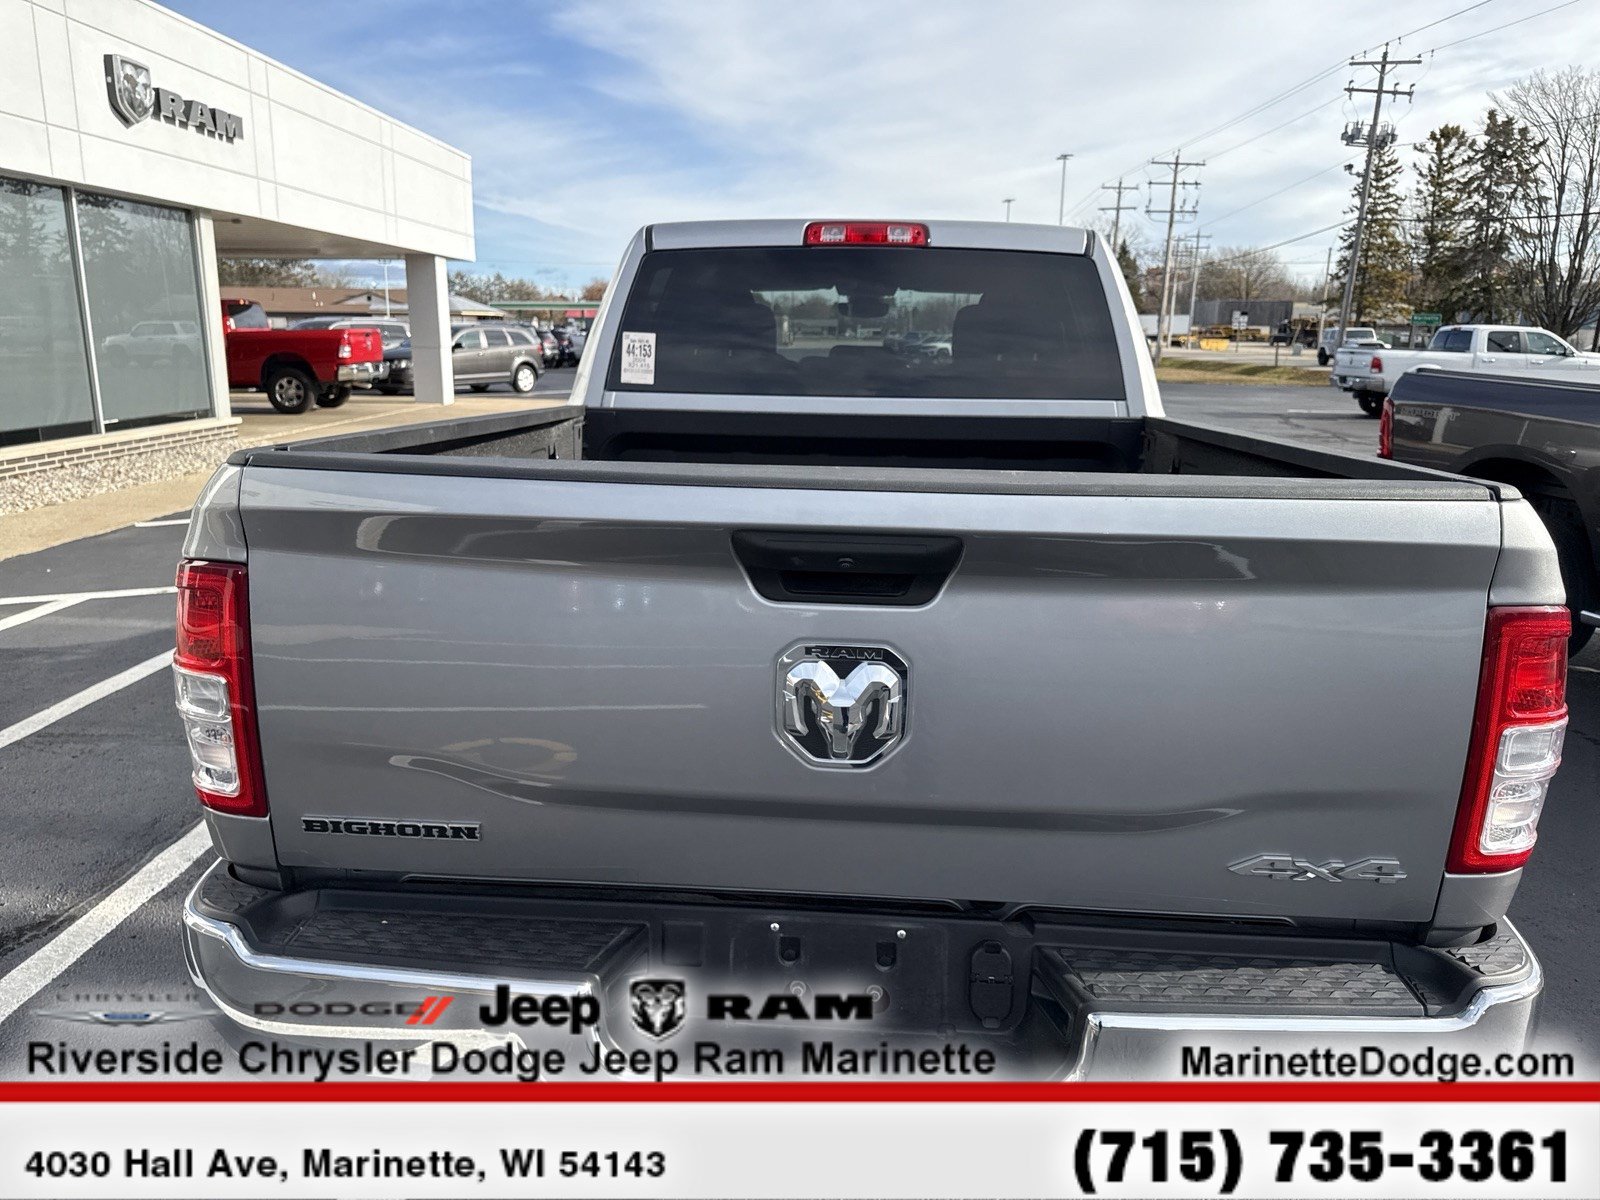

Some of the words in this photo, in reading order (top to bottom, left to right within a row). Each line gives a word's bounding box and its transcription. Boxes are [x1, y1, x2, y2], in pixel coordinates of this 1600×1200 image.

[153, 87, 244, 144] RAM
[805, 647, 884, 660] RAM
[301, 815, 482, 842] BIGHORN
